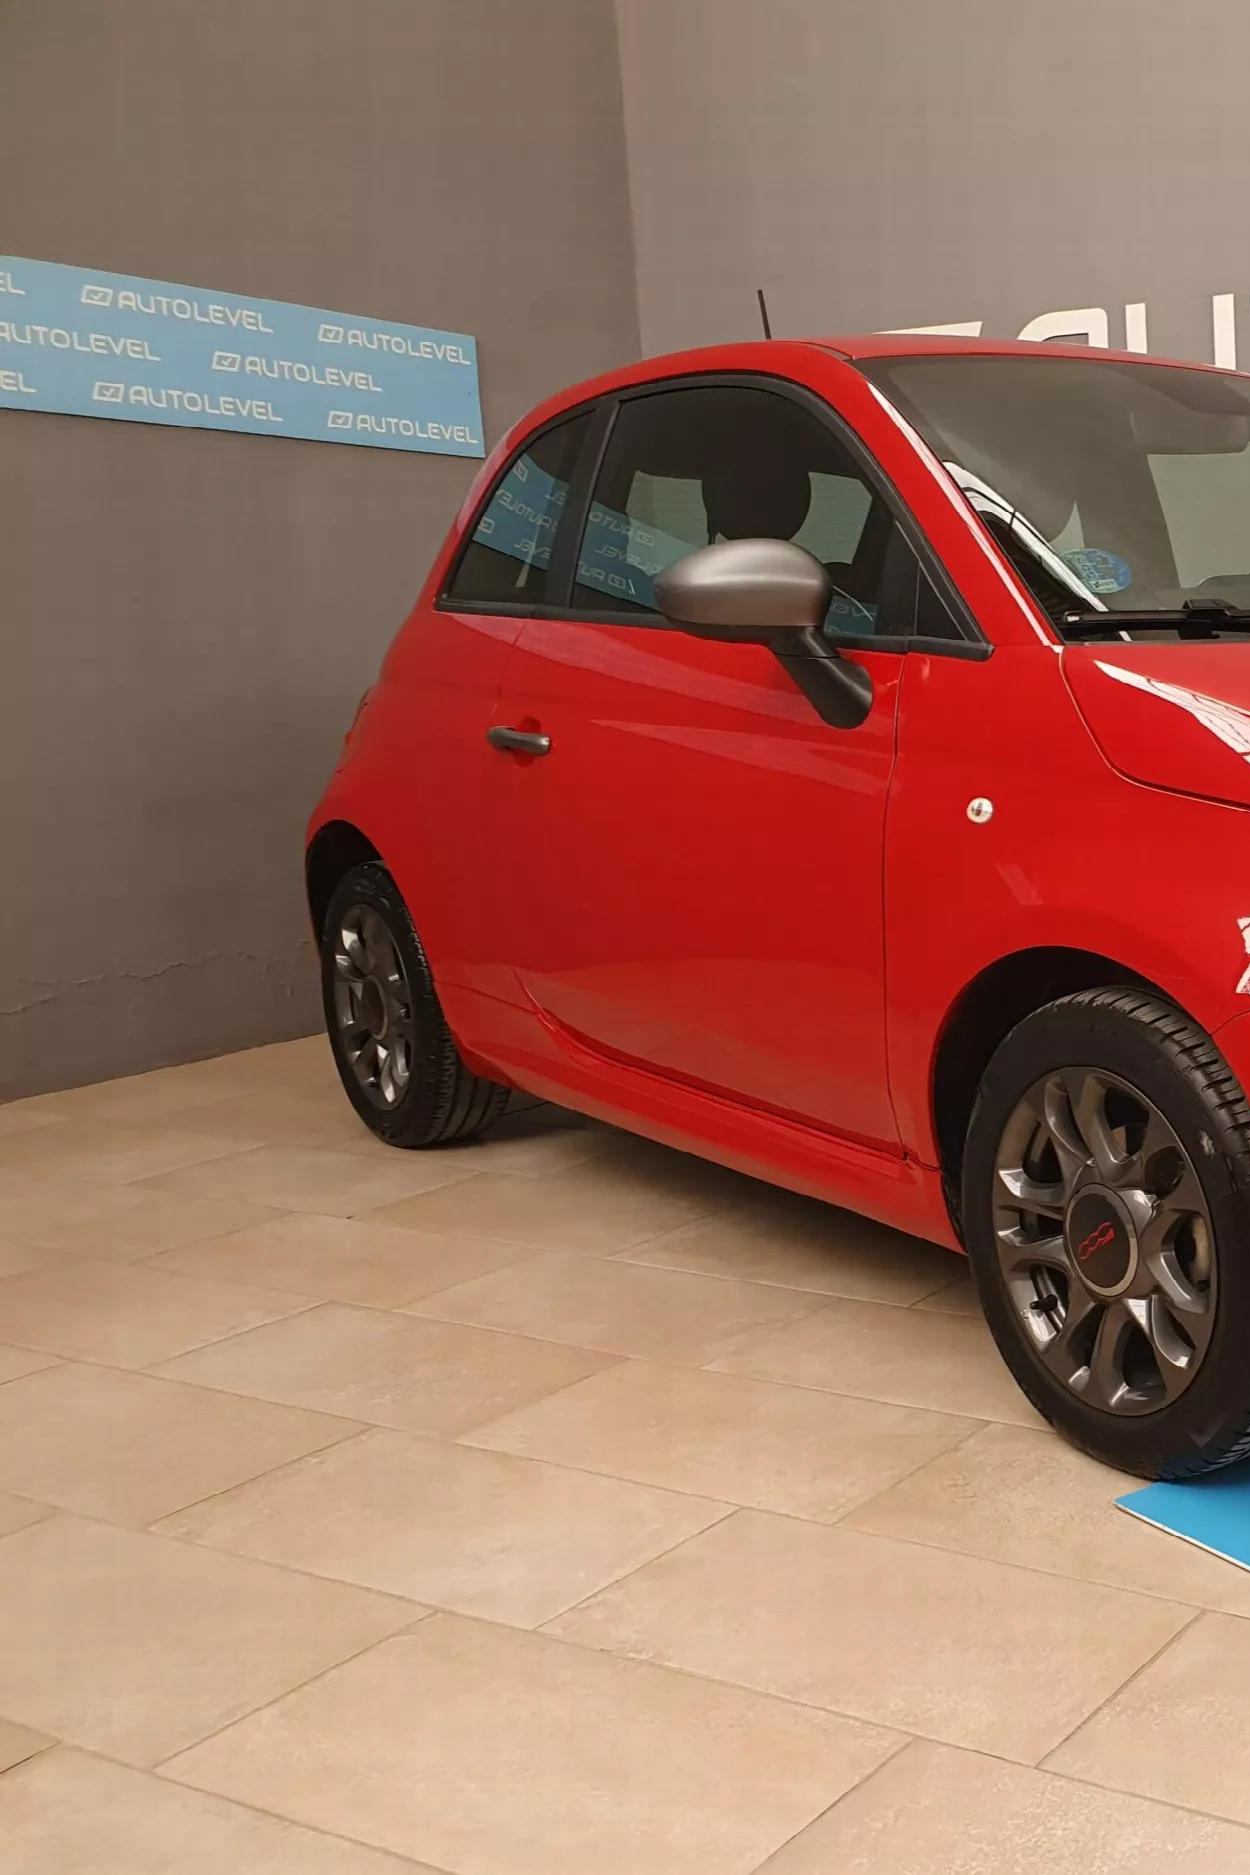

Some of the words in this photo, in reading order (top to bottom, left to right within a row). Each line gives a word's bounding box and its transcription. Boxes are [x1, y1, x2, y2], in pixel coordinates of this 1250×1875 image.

[117, 291, 274, 333] AUTOLEVEL
[0, 321, 161, 361] AUTOLEVEL
[347, 330, 471, 365] AUTOLEVEL
[245, 356, 382, 391] AUTOLEVEL
[129, 386, 283, 422] AUTOLEVEL
[356, 414, 479, 444] AUTOLEVEL
